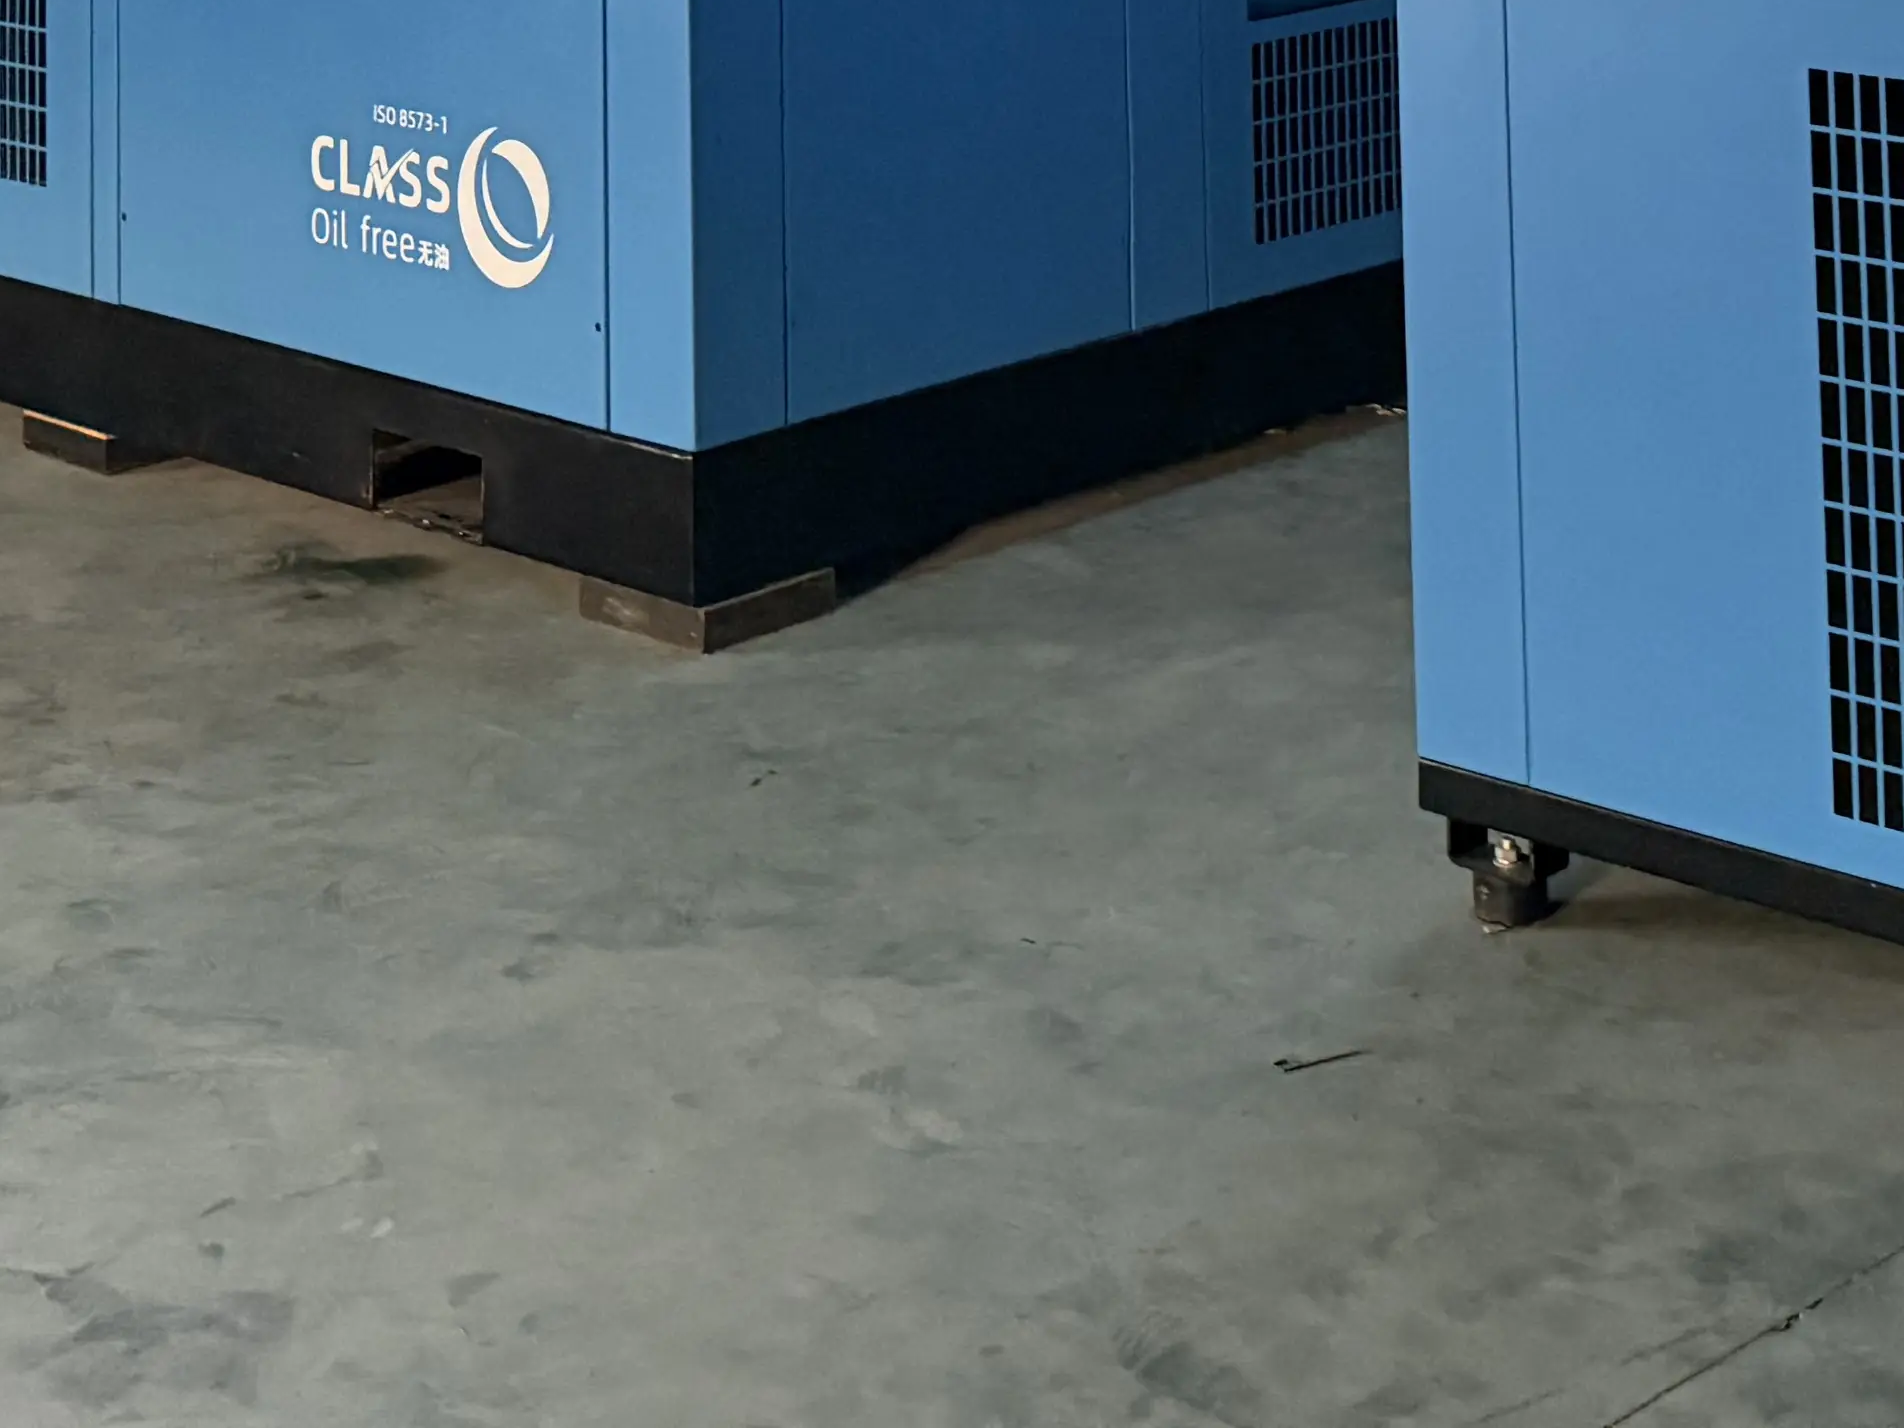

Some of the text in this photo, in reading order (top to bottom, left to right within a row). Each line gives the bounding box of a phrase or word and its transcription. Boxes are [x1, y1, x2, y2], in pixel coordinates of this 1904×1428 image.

[373, 104, 448, 135] ISO 8573-1
[310, 134, 451, 214] CLASS
[311, 207, 349, 249] Oil
